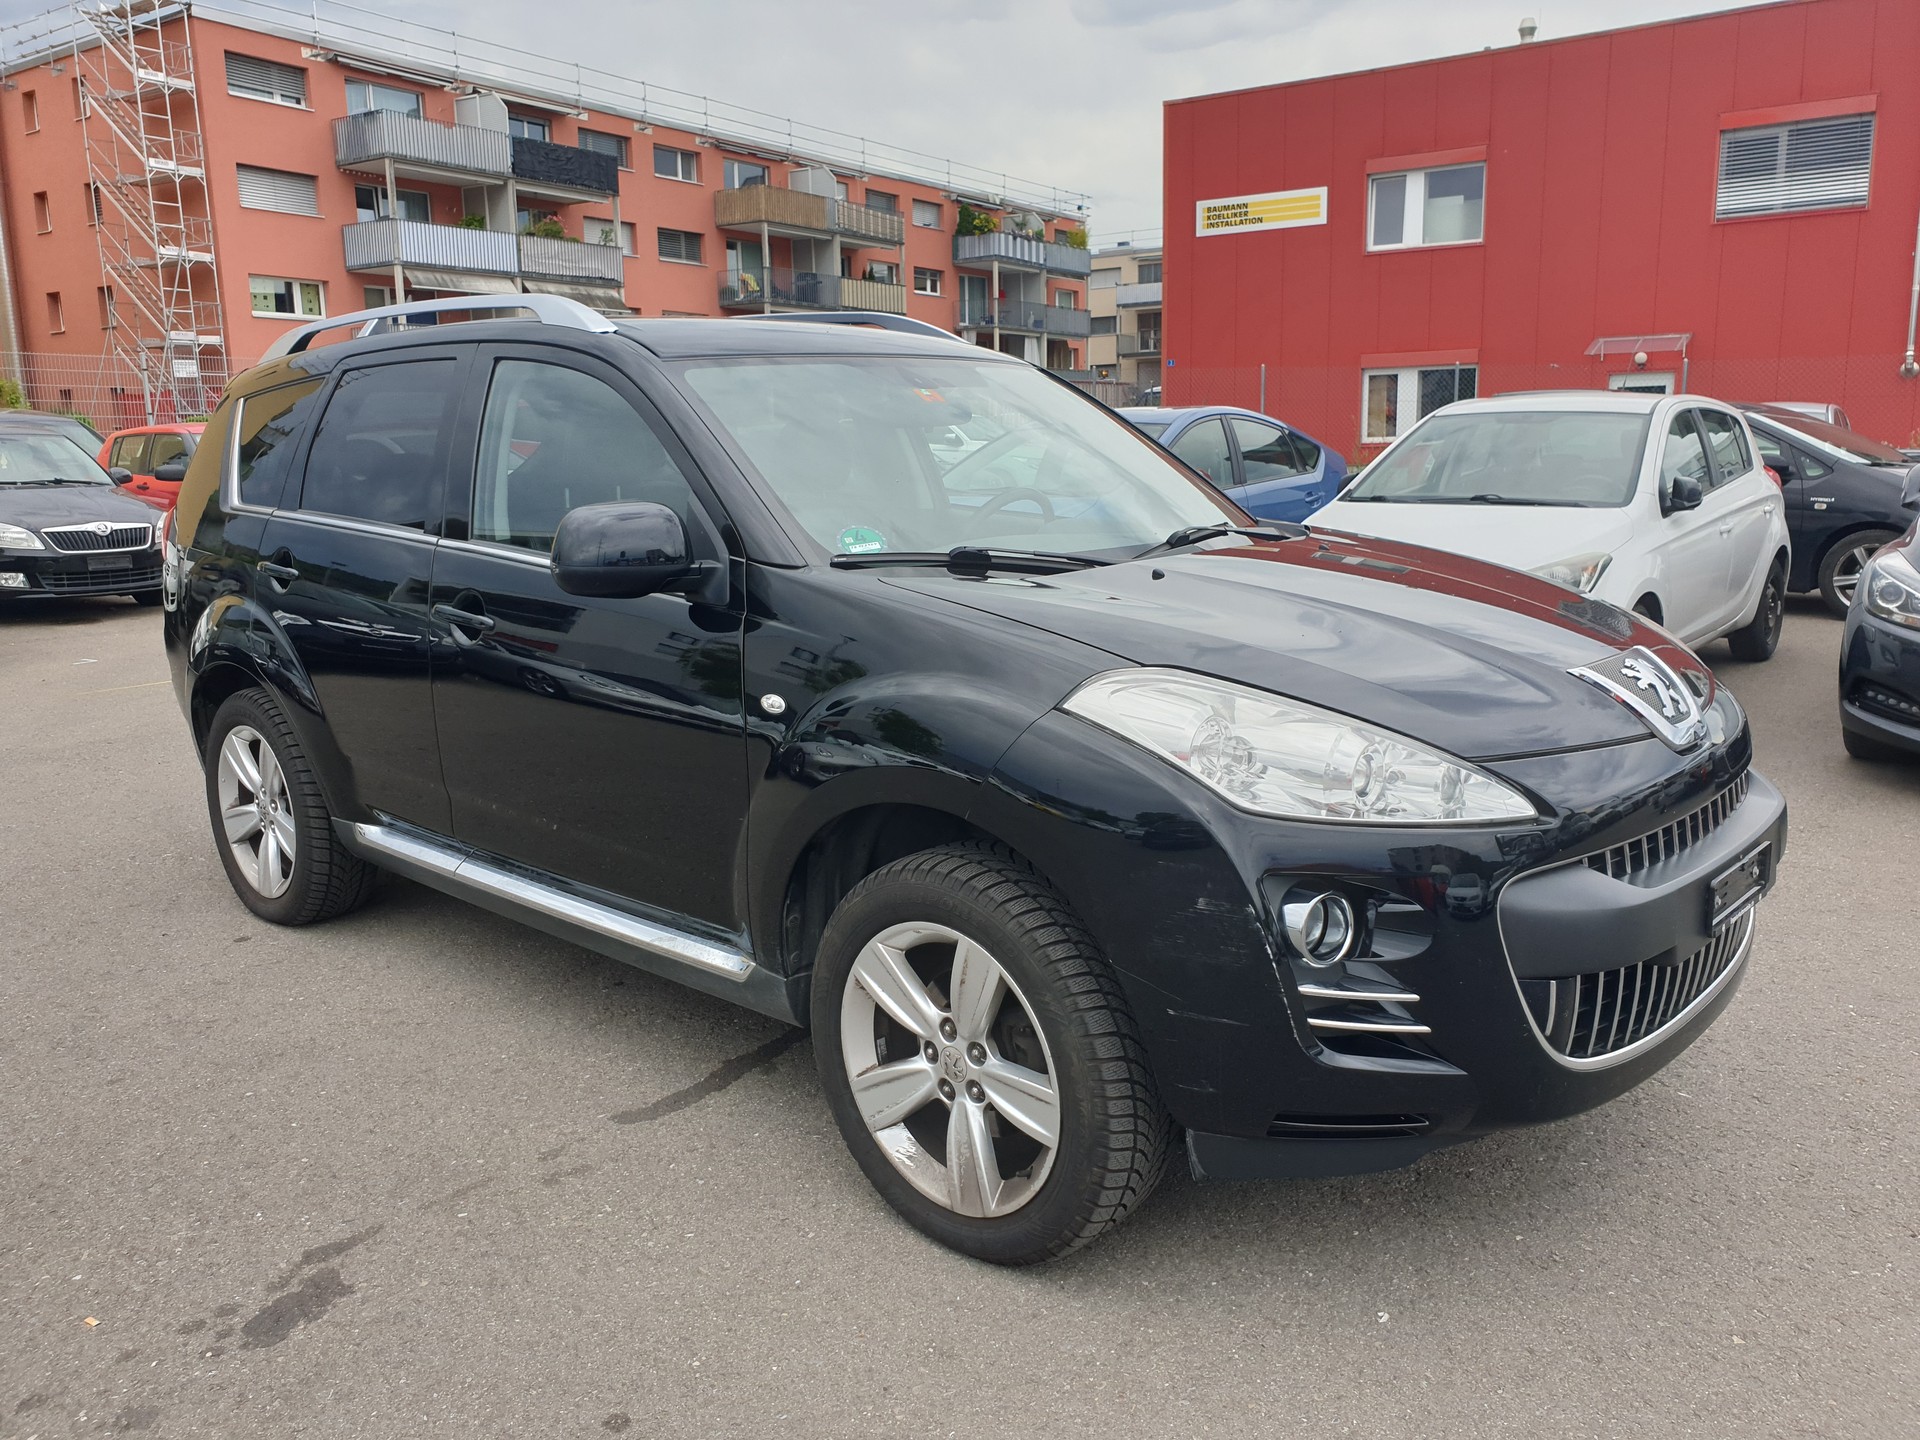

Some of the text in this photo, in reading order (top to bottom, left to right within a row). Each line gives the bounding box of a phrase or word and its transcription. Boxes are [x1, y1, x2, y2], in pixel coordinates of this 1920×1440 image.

[1206, 203, 1249, 213] BAUMANN
[1206, 210, 1249, 221] KOELLIKER
[1206, 217, 1263, 229] INSTALLATION
